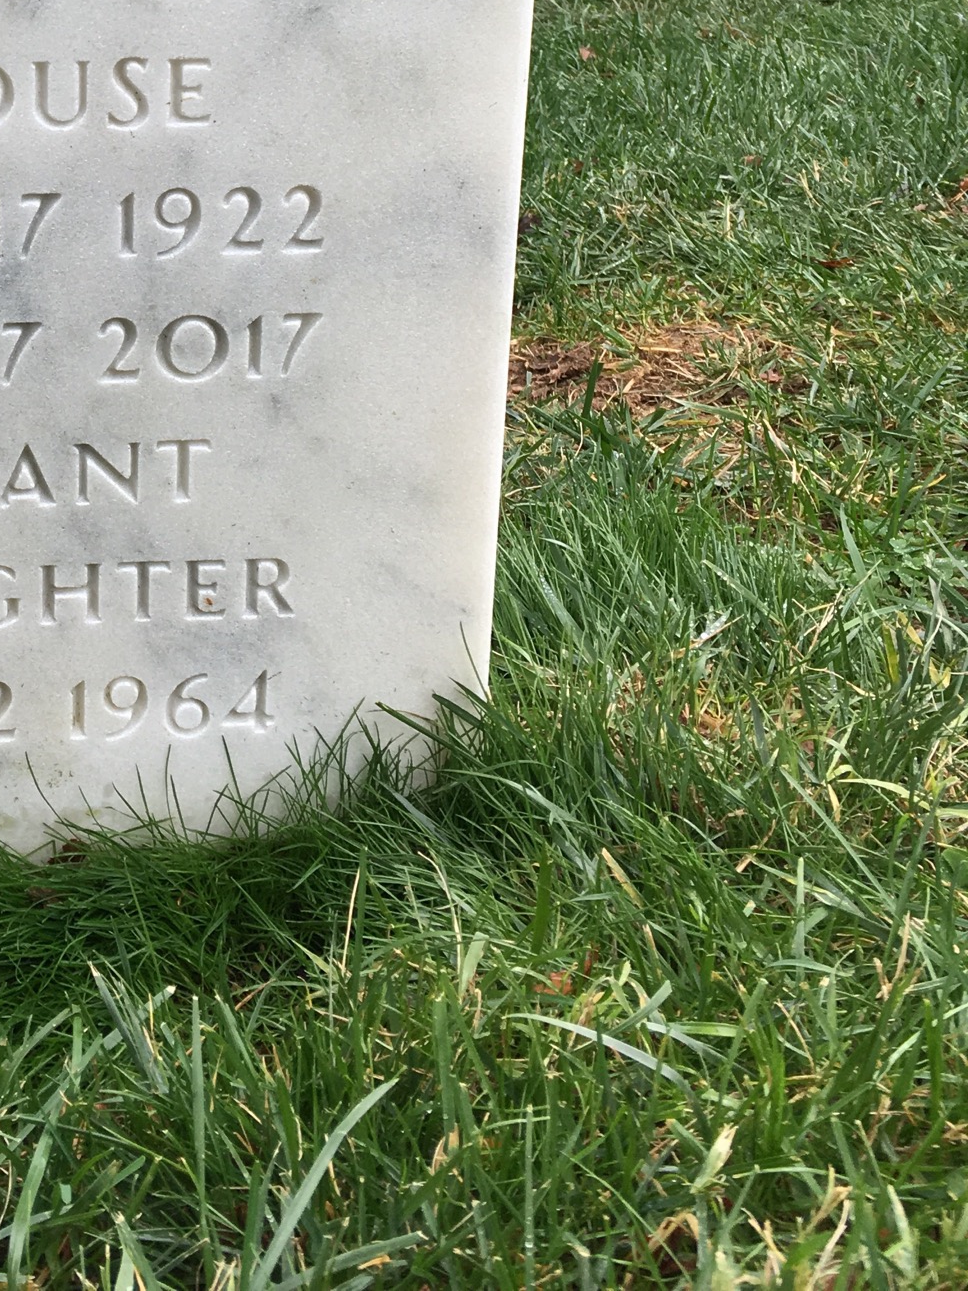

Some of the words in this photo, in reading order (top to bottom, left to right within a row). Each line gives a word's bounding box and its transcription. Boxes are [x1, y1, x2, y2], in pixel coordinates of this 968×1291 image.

[117, 184, 325, 259] 1922
[0, 320, 43, 385] 7
[98, 312, 323, 384] 2017
[68, 668, 276, 742] 1964
